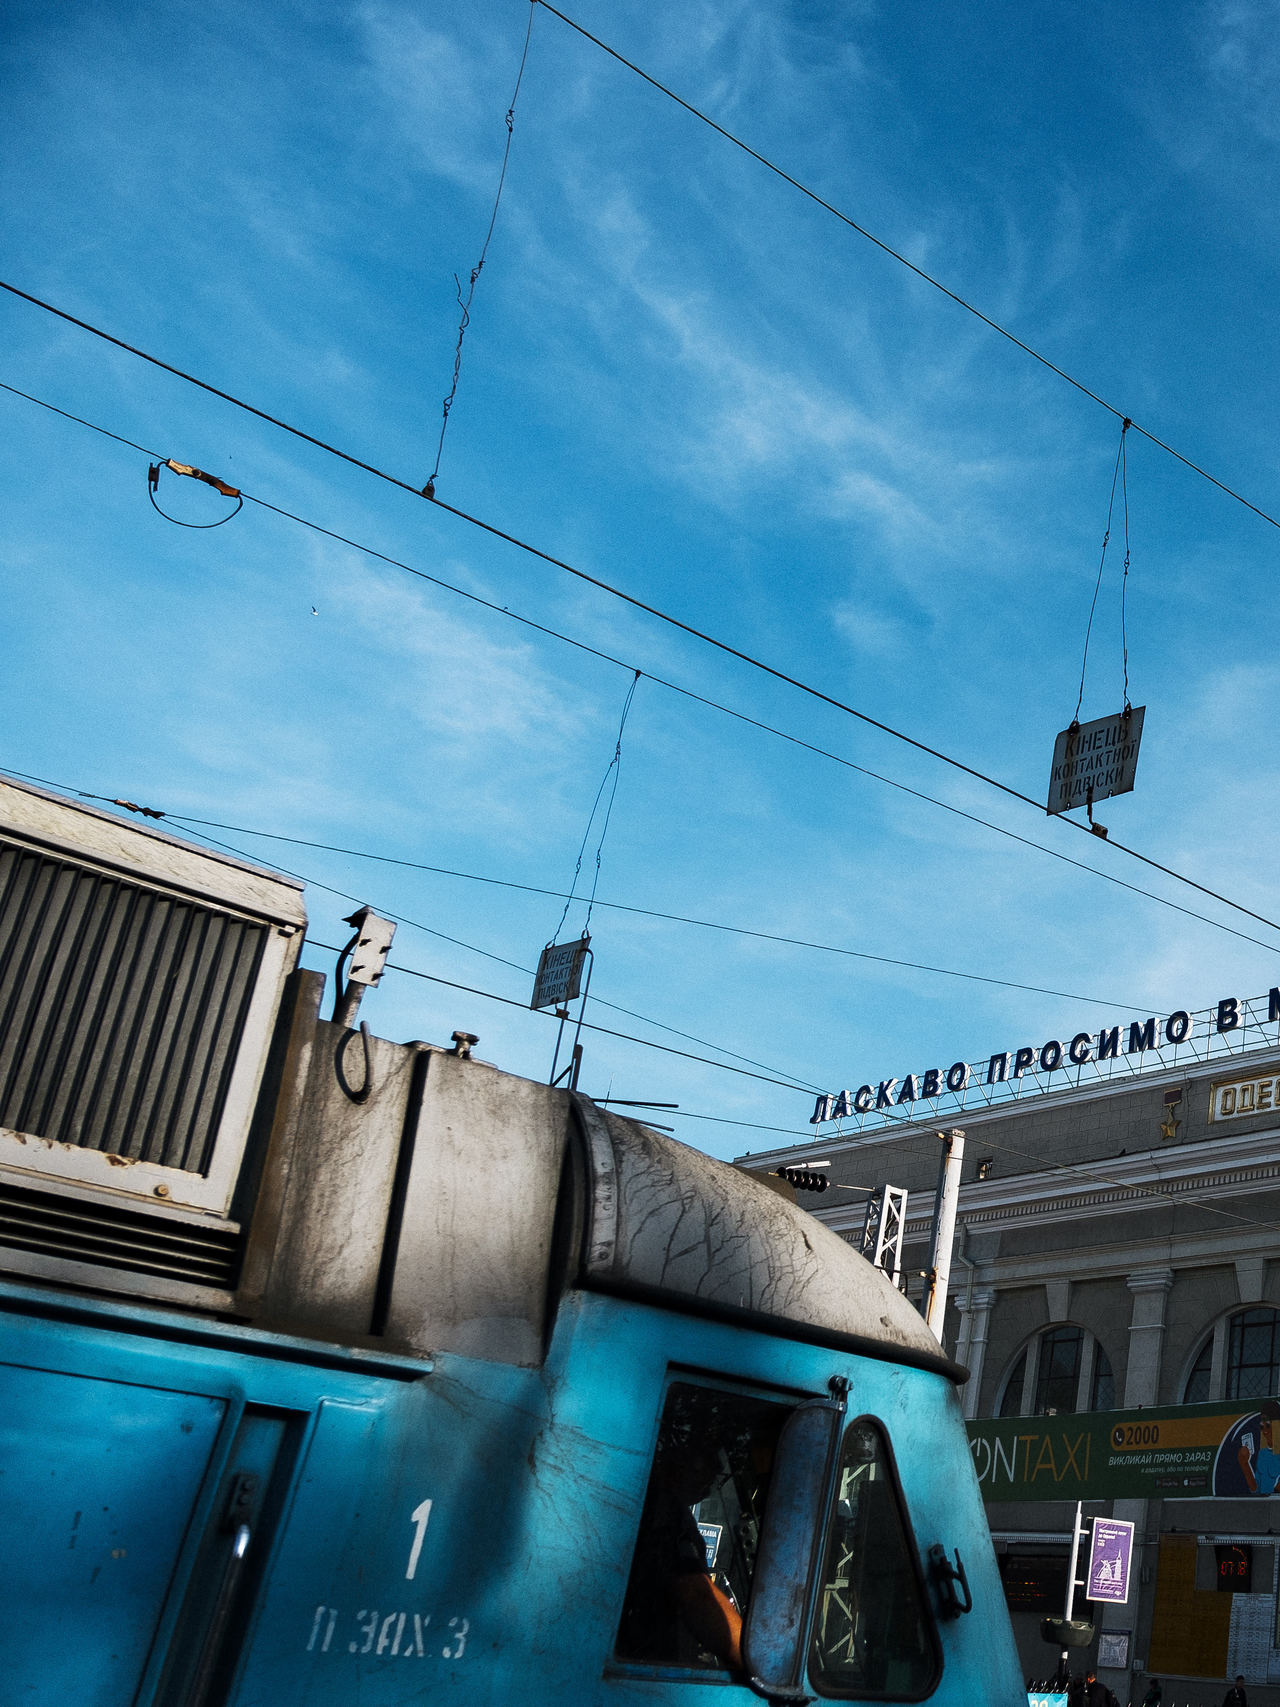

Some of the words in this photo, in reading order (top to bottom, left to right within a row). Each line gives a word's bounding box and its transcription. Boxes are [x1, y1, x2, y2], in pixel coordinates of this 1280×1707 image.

[1054, 739, 1138, 781] КОНТАКТНОЇ
[1064, 724, 1128, 760] КІНЕЦЬ
[1060, 765, 1125, 799] ПІДВІСКИ
[810, 1062, 972, 1124] ЛАСКАВО
[987, 1010, 1193, 1084] ПРОСИМО
[1217, 997, 1244, 1033] В
[1126, 1425, 1160, 1446] 2000
[1108, 1452, 1152, 1466] ВИКЛИКАЙ
[1153, 1453, 1183, 1464] ПРЯМО
[1184, 1451, 1212, 1463] ЗАРАЗ
[405, 1499, 432, 1580] 1
